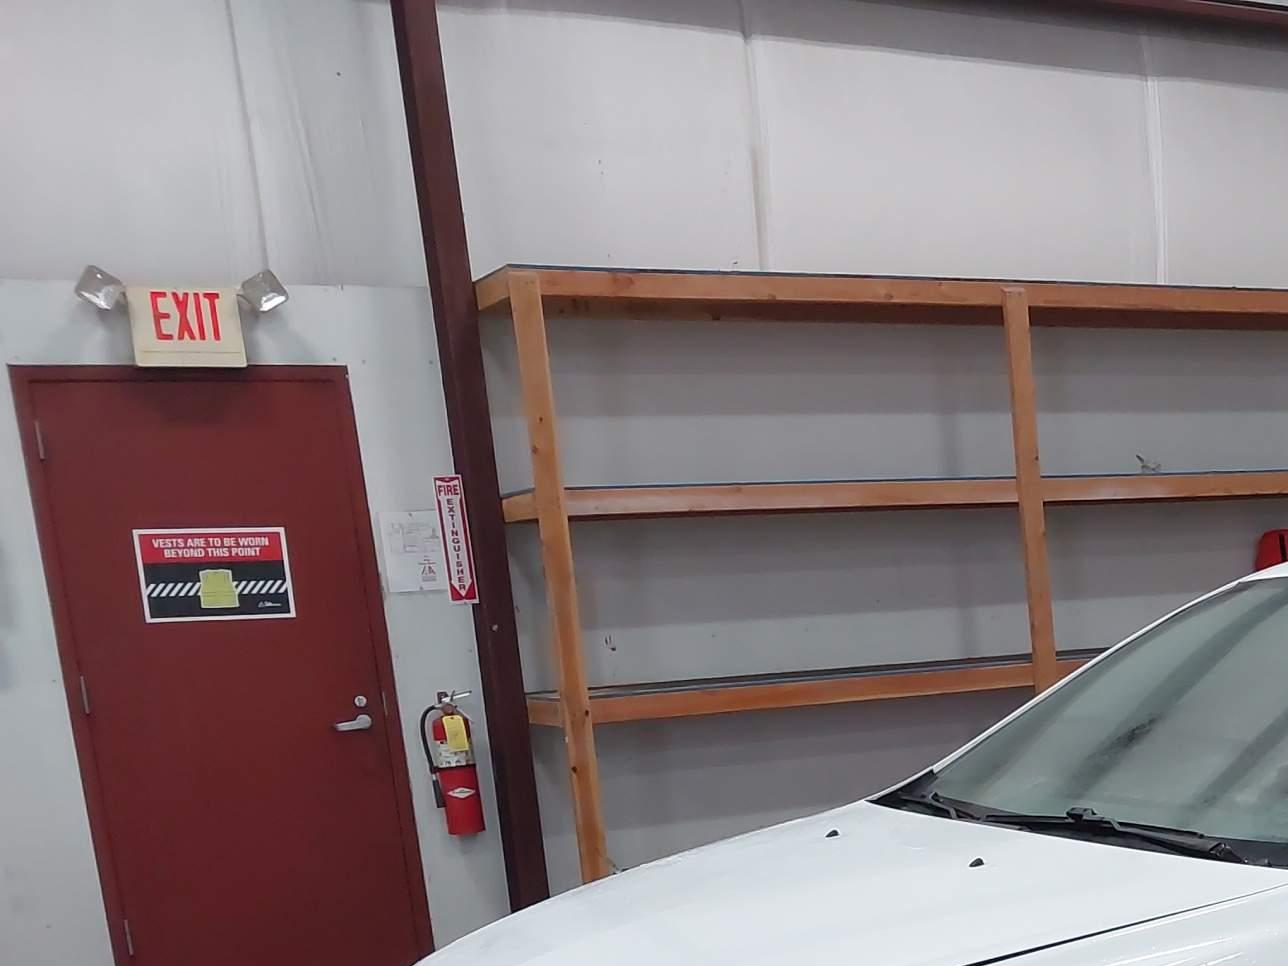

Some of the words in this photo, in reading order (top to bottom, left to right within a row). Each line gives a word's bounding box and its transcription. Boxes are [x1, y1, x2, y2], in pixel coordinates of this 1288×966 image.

[149, 290, 222, 342] EXIT
[437, 485, 459, 496] FIRE
[152, 538, 184, 548] VESTS
[187, 538, 206, 547] ARE
[208, 537, 221, 547] TO
[224, 537, 237, 546] BE
[239, 537, 269, 546] WORN
[446, 498, 466, 591] EXTINGUISHER
[164, 548, 205, 558] BEYOND
[206, 547, 229, 557] THIS
[231, 547, 261, 556] POINT
